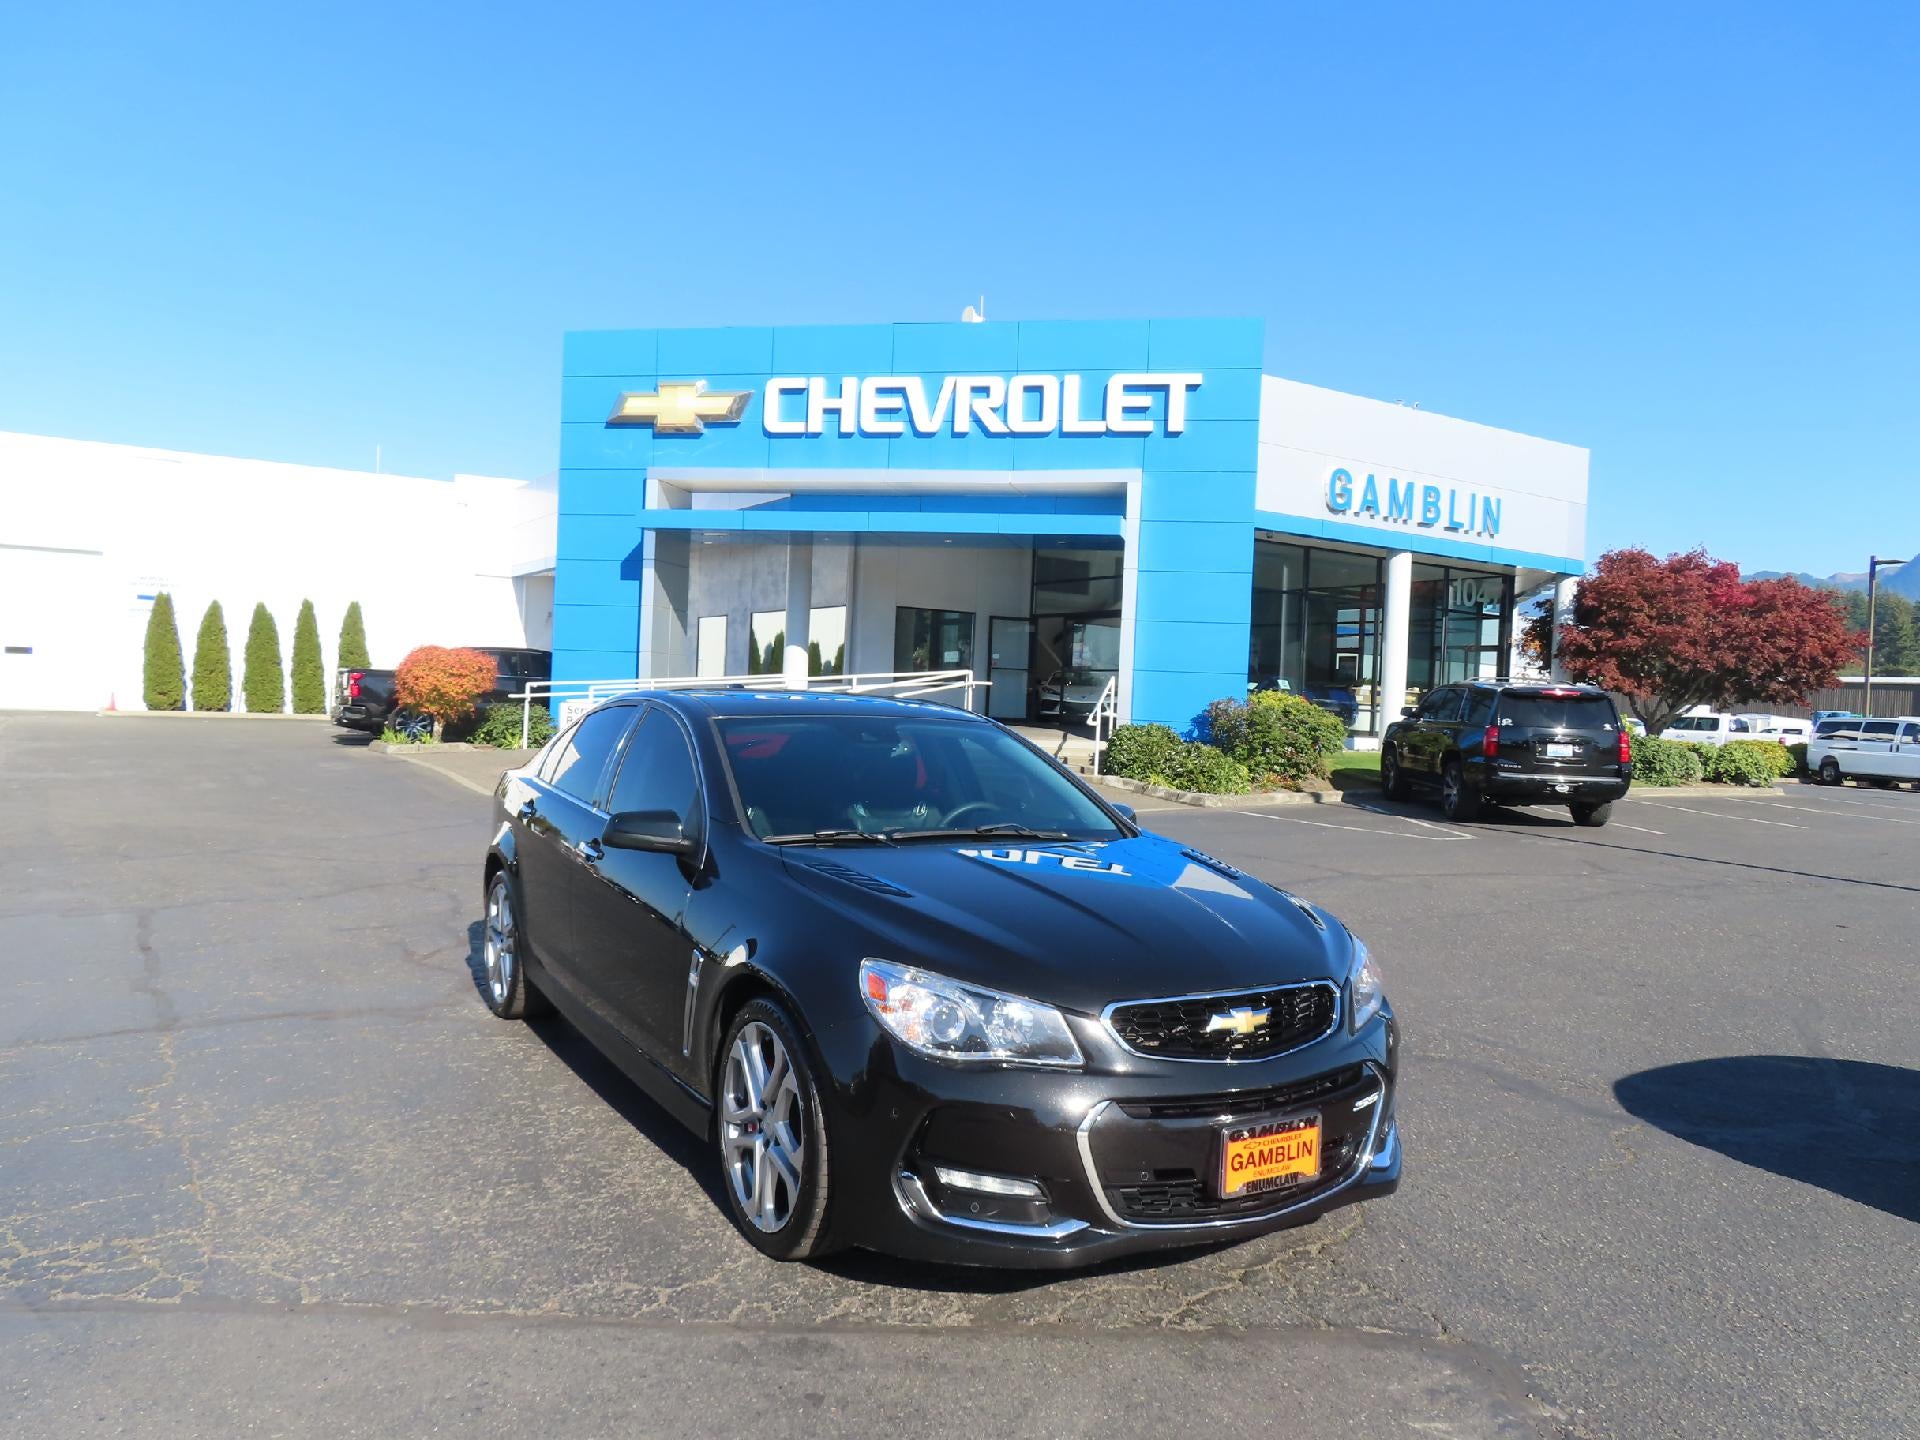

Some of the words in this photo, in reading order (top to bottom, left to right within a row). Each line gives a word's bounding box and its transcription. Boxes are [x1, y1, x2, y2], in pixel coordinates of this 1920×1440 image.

[763, 373, 1203, 436] CHEVROLET
[1328, 468, 1501, 536] GAMBLIN
[1229, 1115, 1318, 1142] GAMBLIN
[1262, 1133, 1302, 1146] CHEVROLET
[1230, 1140, 1313, 1172] GAMBLIN
[1246, 1172, 1299, 1193] ENUMCLAW
